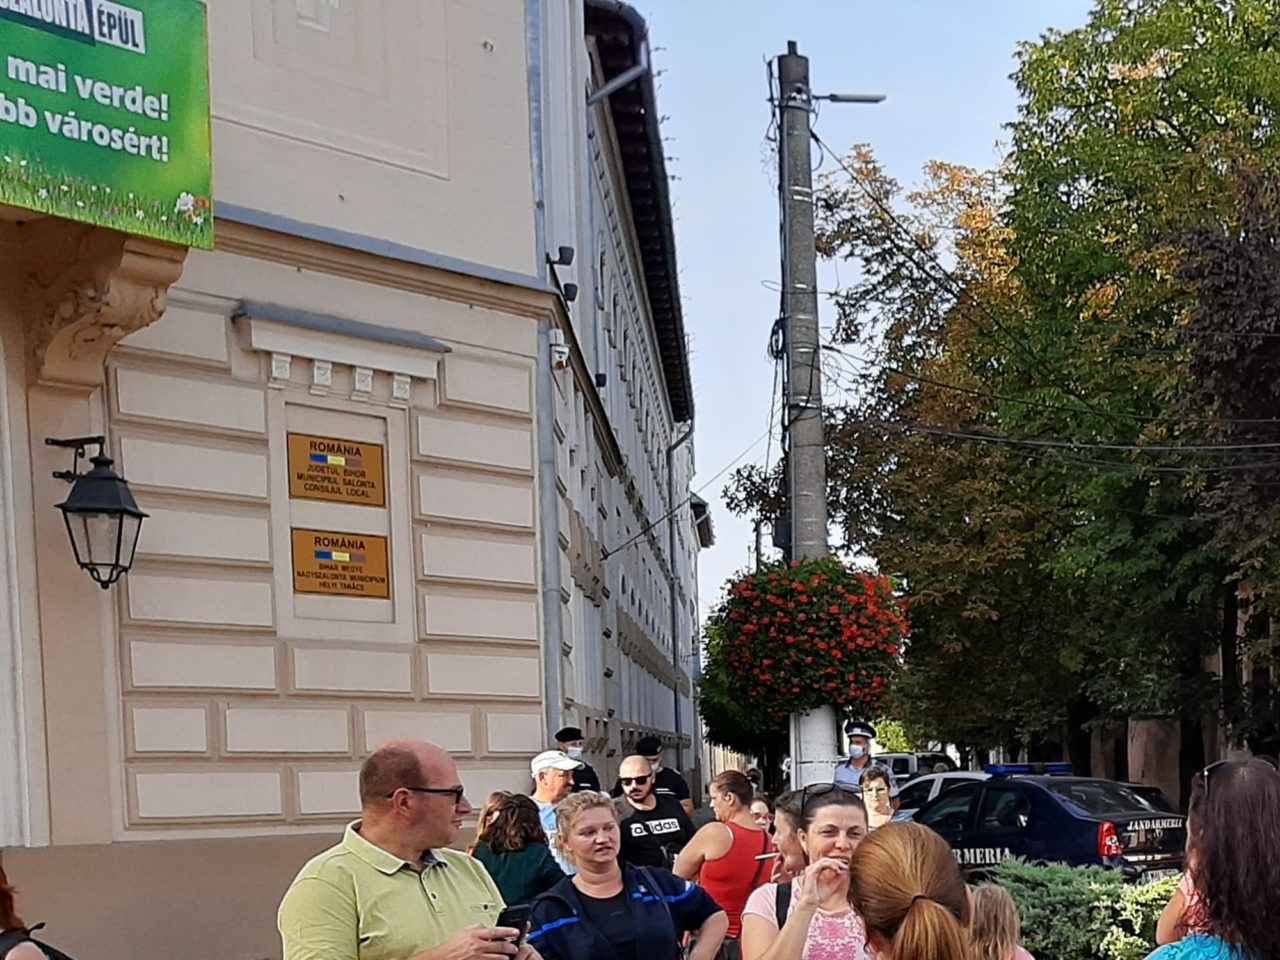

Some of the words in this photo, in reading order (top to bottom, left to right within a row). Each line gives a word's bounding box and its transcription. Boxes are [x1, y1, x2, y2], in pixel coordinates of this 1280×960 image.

[97, 4, 140, 48] ÉPÜL
[7, 55, 67, 93] mai
[74, 75, 169, 121] verde!
[44, 110, 169, 162] városért!
[342, 478, 376, 489] SALONTA
[634, 821, 678, 835] aidas
